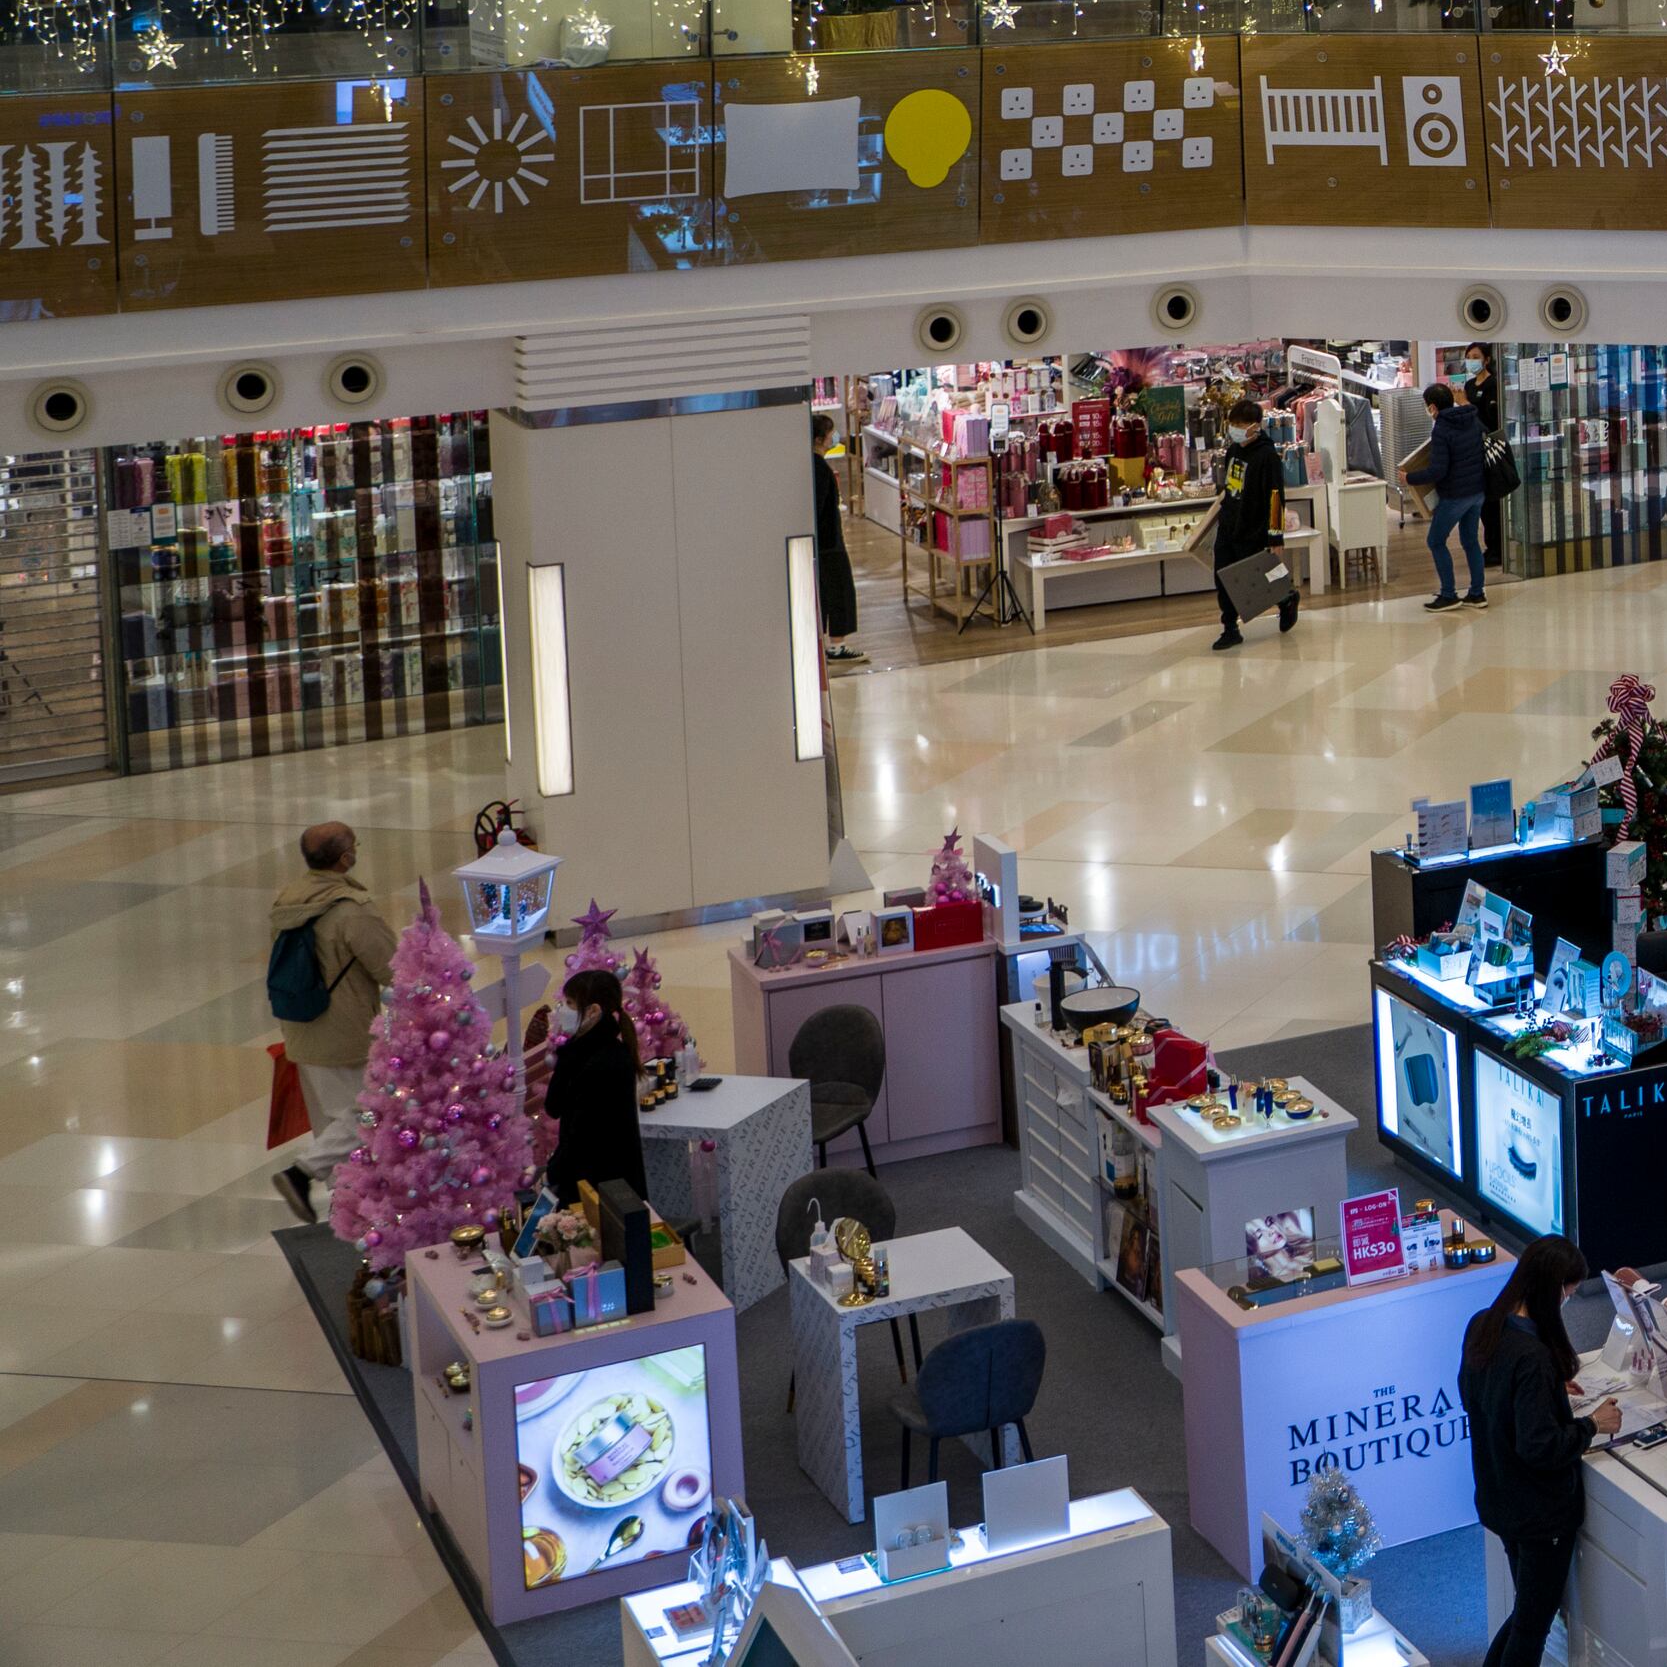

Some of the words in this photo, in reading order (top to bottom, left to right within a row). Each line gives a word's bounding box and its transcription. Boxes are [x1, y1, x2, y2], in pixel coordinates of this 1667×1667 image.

[1353, 1240, 1396, 1261] HK$30
[1373, 1384, 1396, 1398] THE
[1288, 1387, 1465, 1451] MINERA
